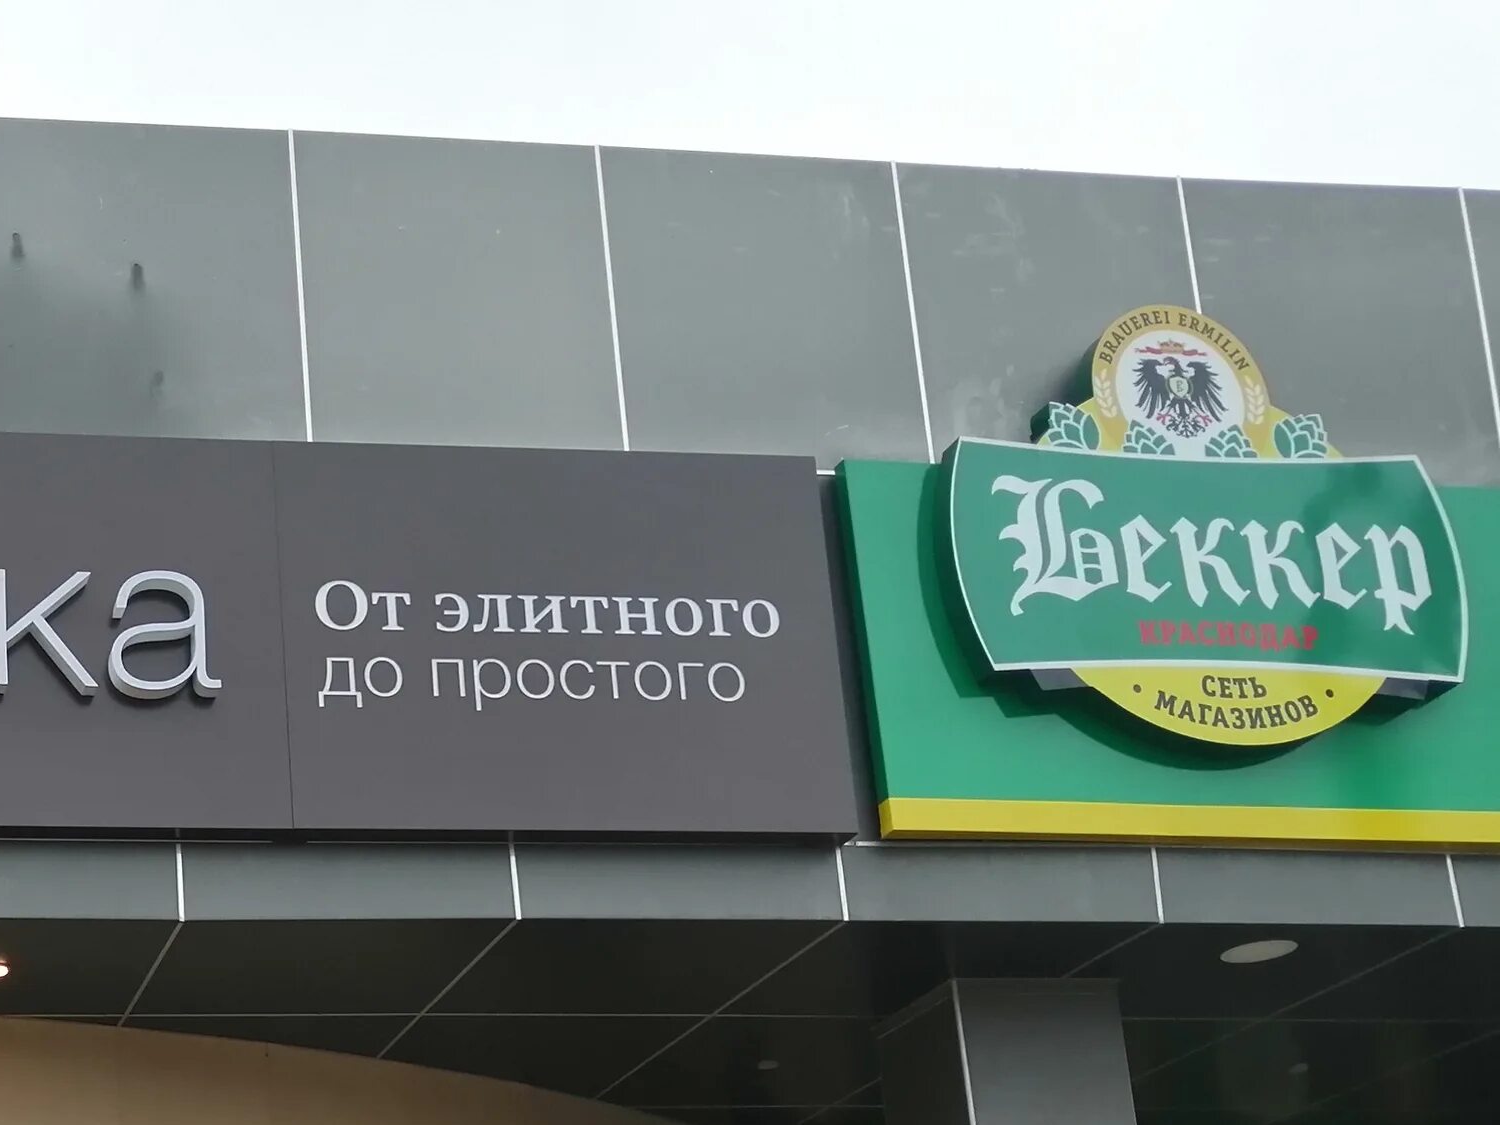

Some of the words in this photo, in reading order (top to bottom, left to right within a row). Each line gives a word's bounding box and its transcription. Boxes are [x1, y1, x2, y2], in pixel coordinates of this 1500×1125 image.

[1099, 310, 1171, 365] BRAUEREI
[1178, 312, 1250, 371] ERMILIN
[991, 474, 1433, 635] Беккер
[314, 580, 411, 632] От
[434, 592, 781, 638] элитного
[1138, 619, 1320, 653] КРАСНОДАР
[318, 656, 403, 708] до
[431, 657, 746, 711] простого
[1153, 690, 1319, 730] МАГАЗИНОВ
[1201, 674, 1268, 699] СЕТЬ
